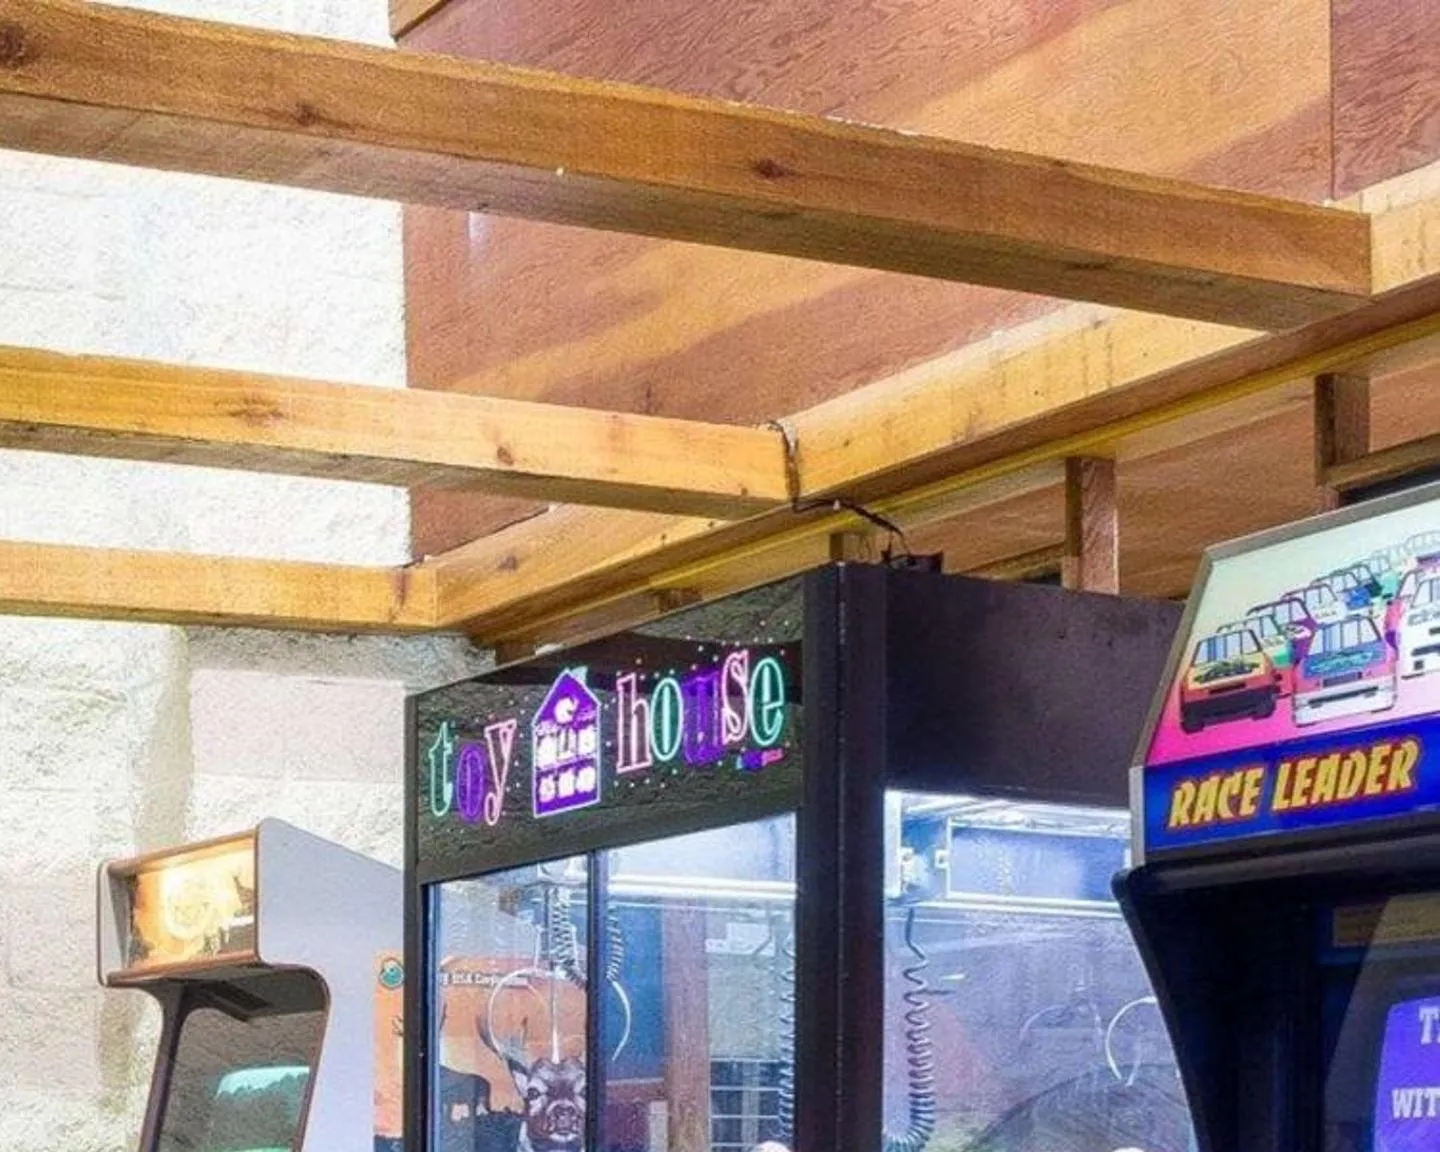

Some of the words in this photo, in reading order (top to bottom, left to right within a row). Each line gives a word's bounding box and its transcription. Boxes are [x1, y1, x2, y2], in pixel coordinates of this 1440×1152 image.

[428, 718, 517, 826] toy
[616, 649, 785, 774] house
[1168, 766, 1264, 829] RACE
[1271, 738, 1421, 812] LEADER
